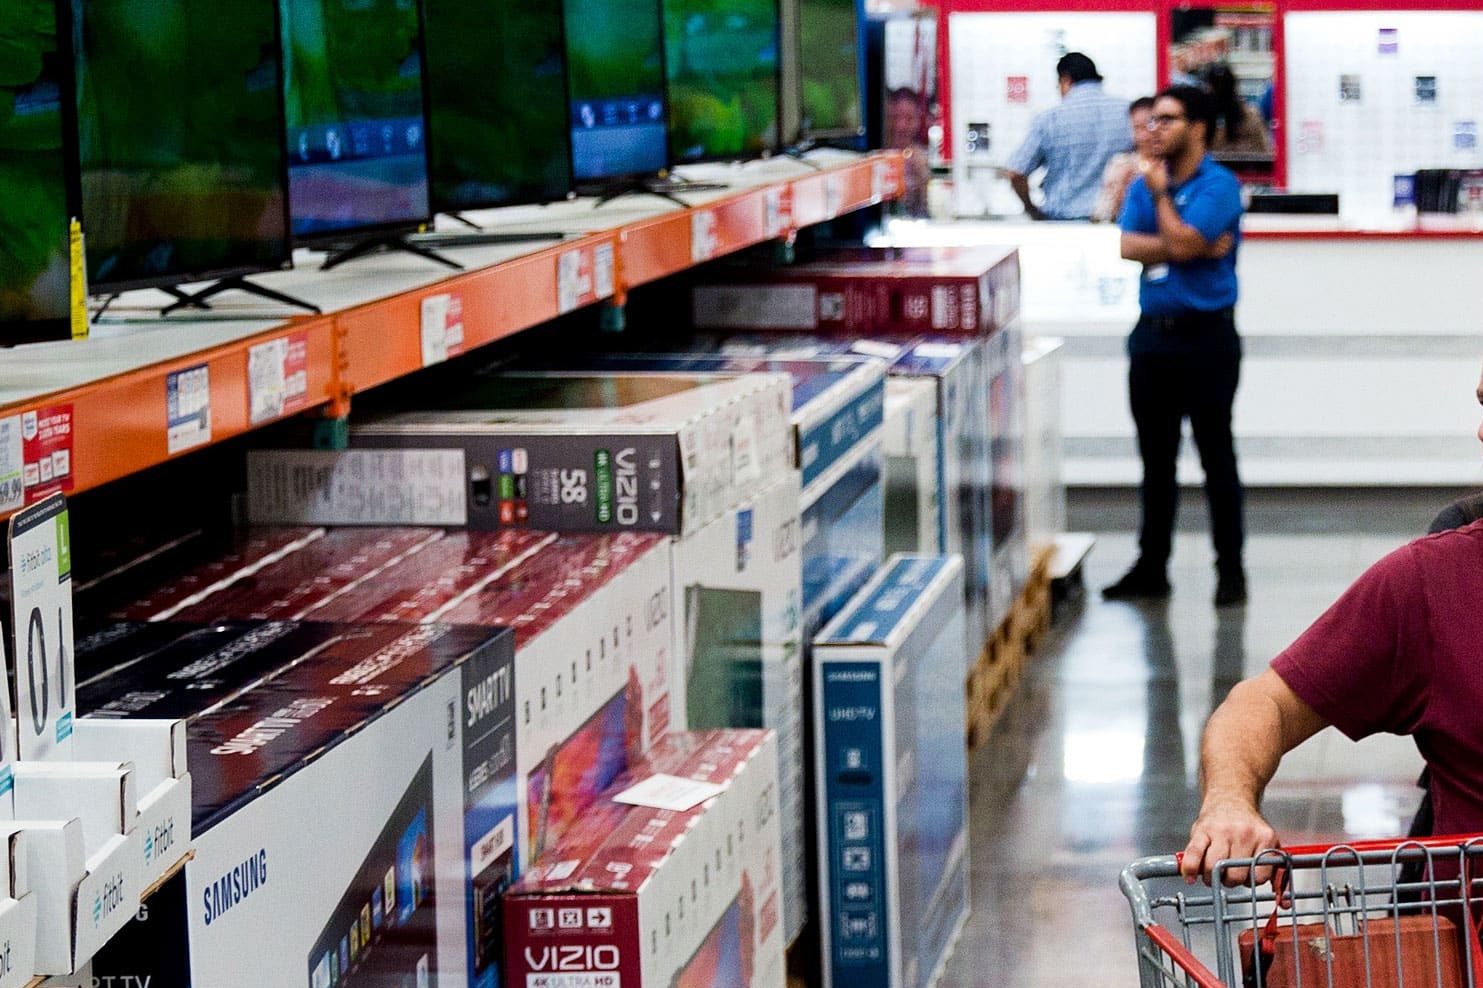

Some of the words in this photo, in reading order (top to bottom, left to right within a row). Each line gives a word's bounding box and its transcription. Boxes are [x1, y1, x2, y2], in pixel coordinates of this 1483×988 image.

[560, 468, 587, 504] 58
[615, 448, 638, 525] VIZIO
[467, 671, 497, 728] SMART
[153, 816, 174, 860] fitbit
[103, 871, 123, 919] fitbit
[203, 848, 267, 926] SAMSUNG
[524, 945, 620, 971] VIZIO
[551, 977, 590, 987] ULTRA
[594, 977, 613, 987] HD
